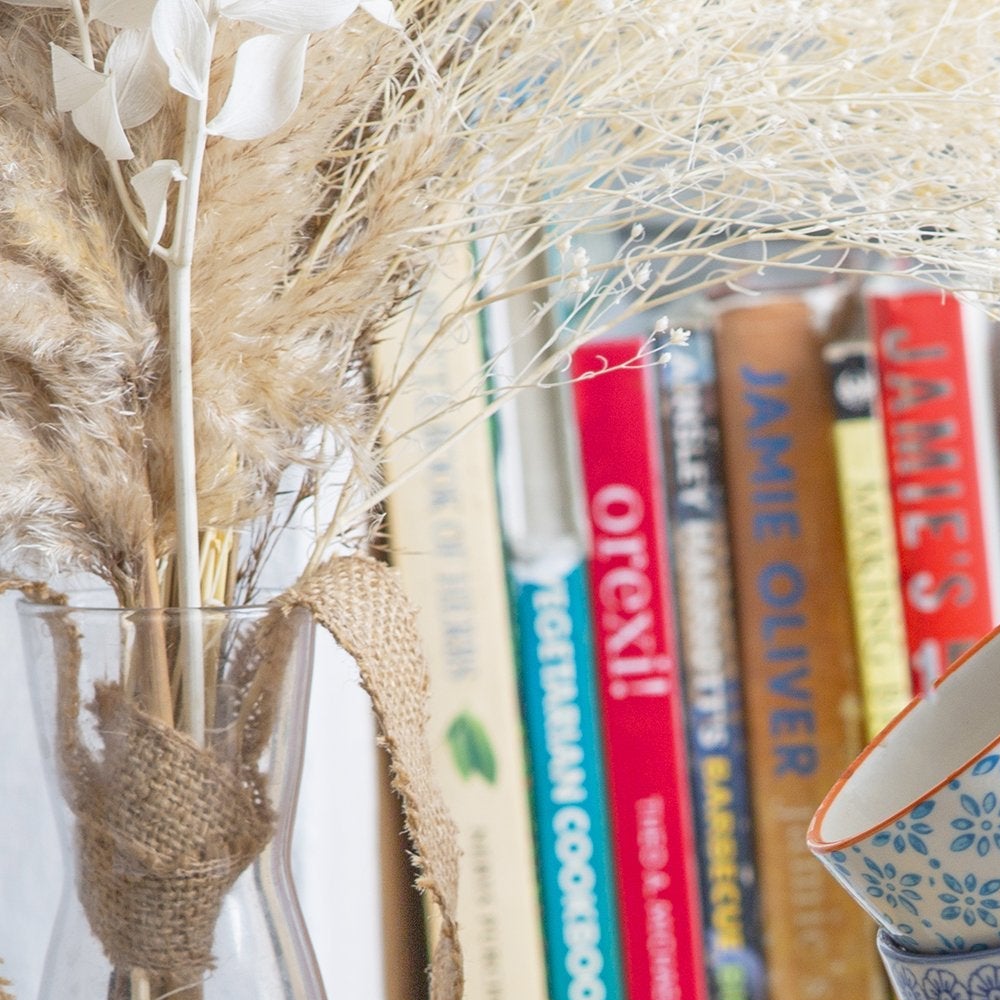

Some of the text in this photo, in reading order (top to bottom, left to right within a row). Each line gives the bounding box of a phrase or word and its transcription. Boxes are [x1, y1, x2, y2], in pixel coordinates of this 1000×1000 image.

[591, 482, 674, 701] orexi!
[739, 365, 820, 780] JAMIE OLIVER
[880, 327, 976, 614] JAMIE'S
